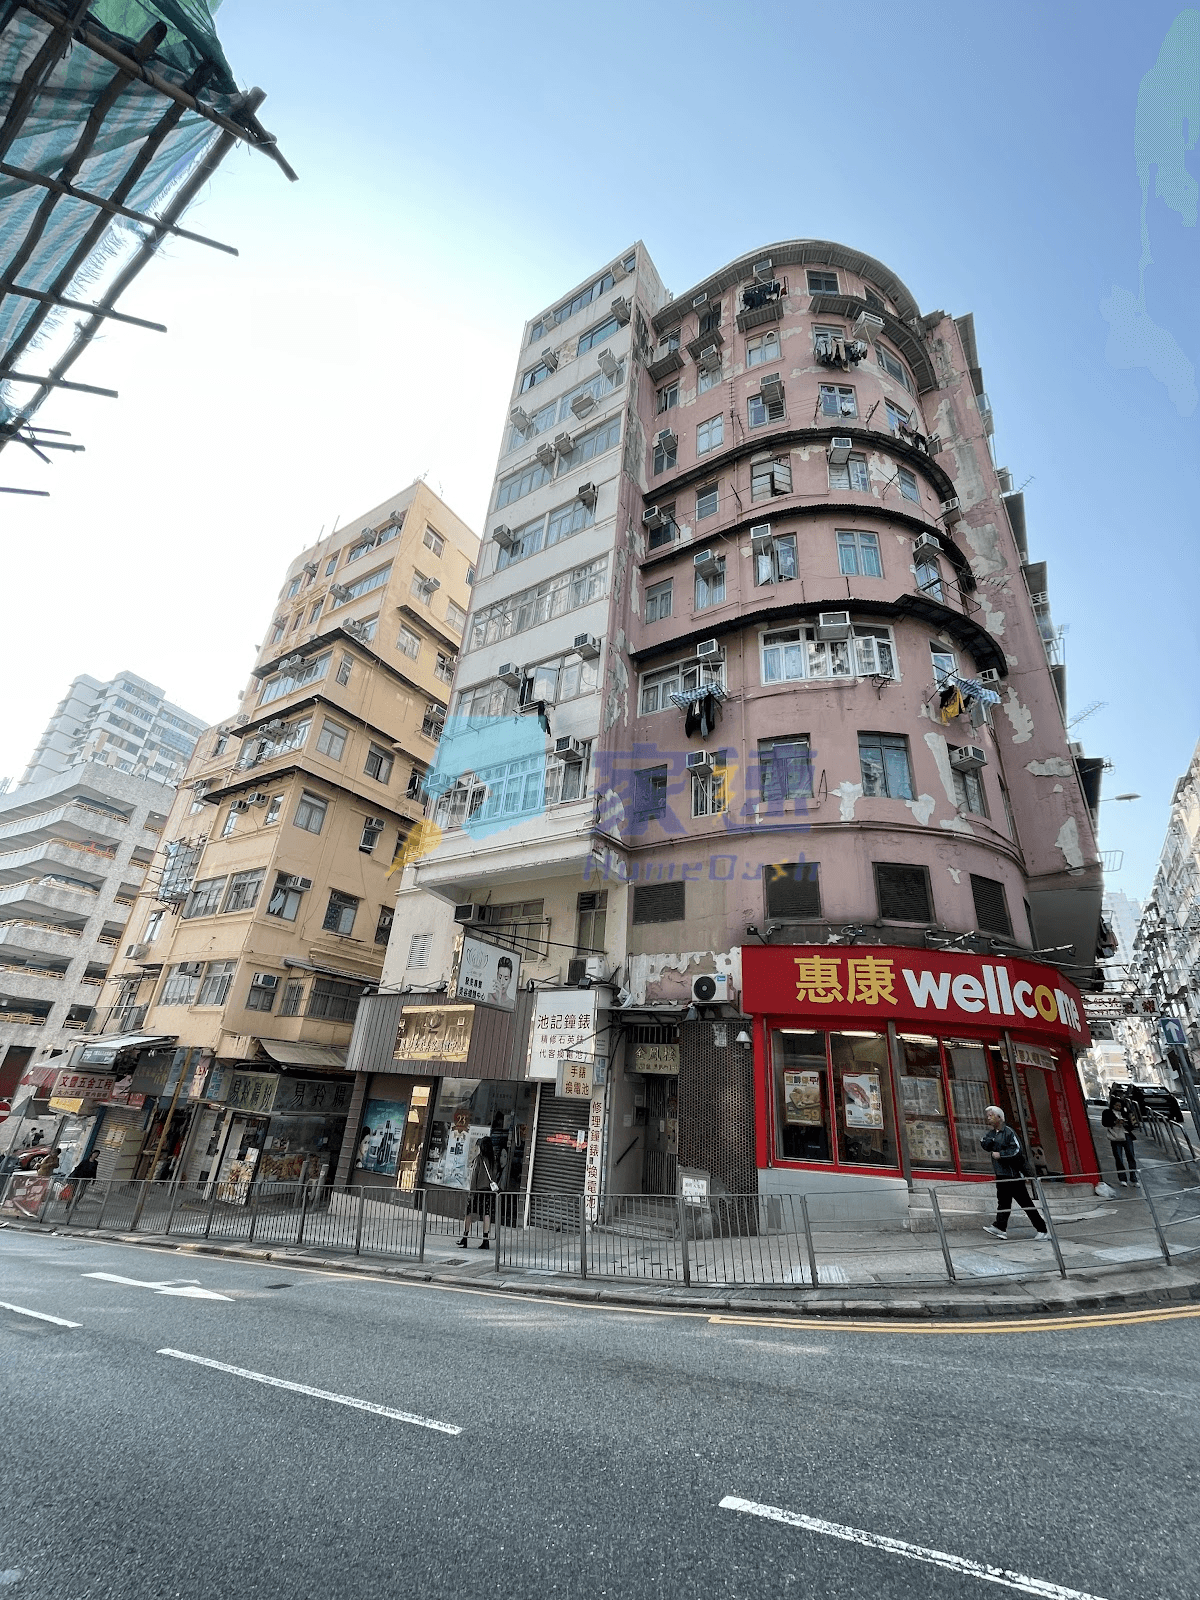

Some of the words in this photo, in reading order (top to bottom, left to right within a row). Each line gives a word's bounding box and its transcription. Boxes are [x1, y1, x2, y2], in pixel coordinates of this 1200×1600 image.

[794, 955, 899, 1005] 惠康
[902, 965, 1082, 1033] wellcome
[864, 1113, 882, 1125] 39
